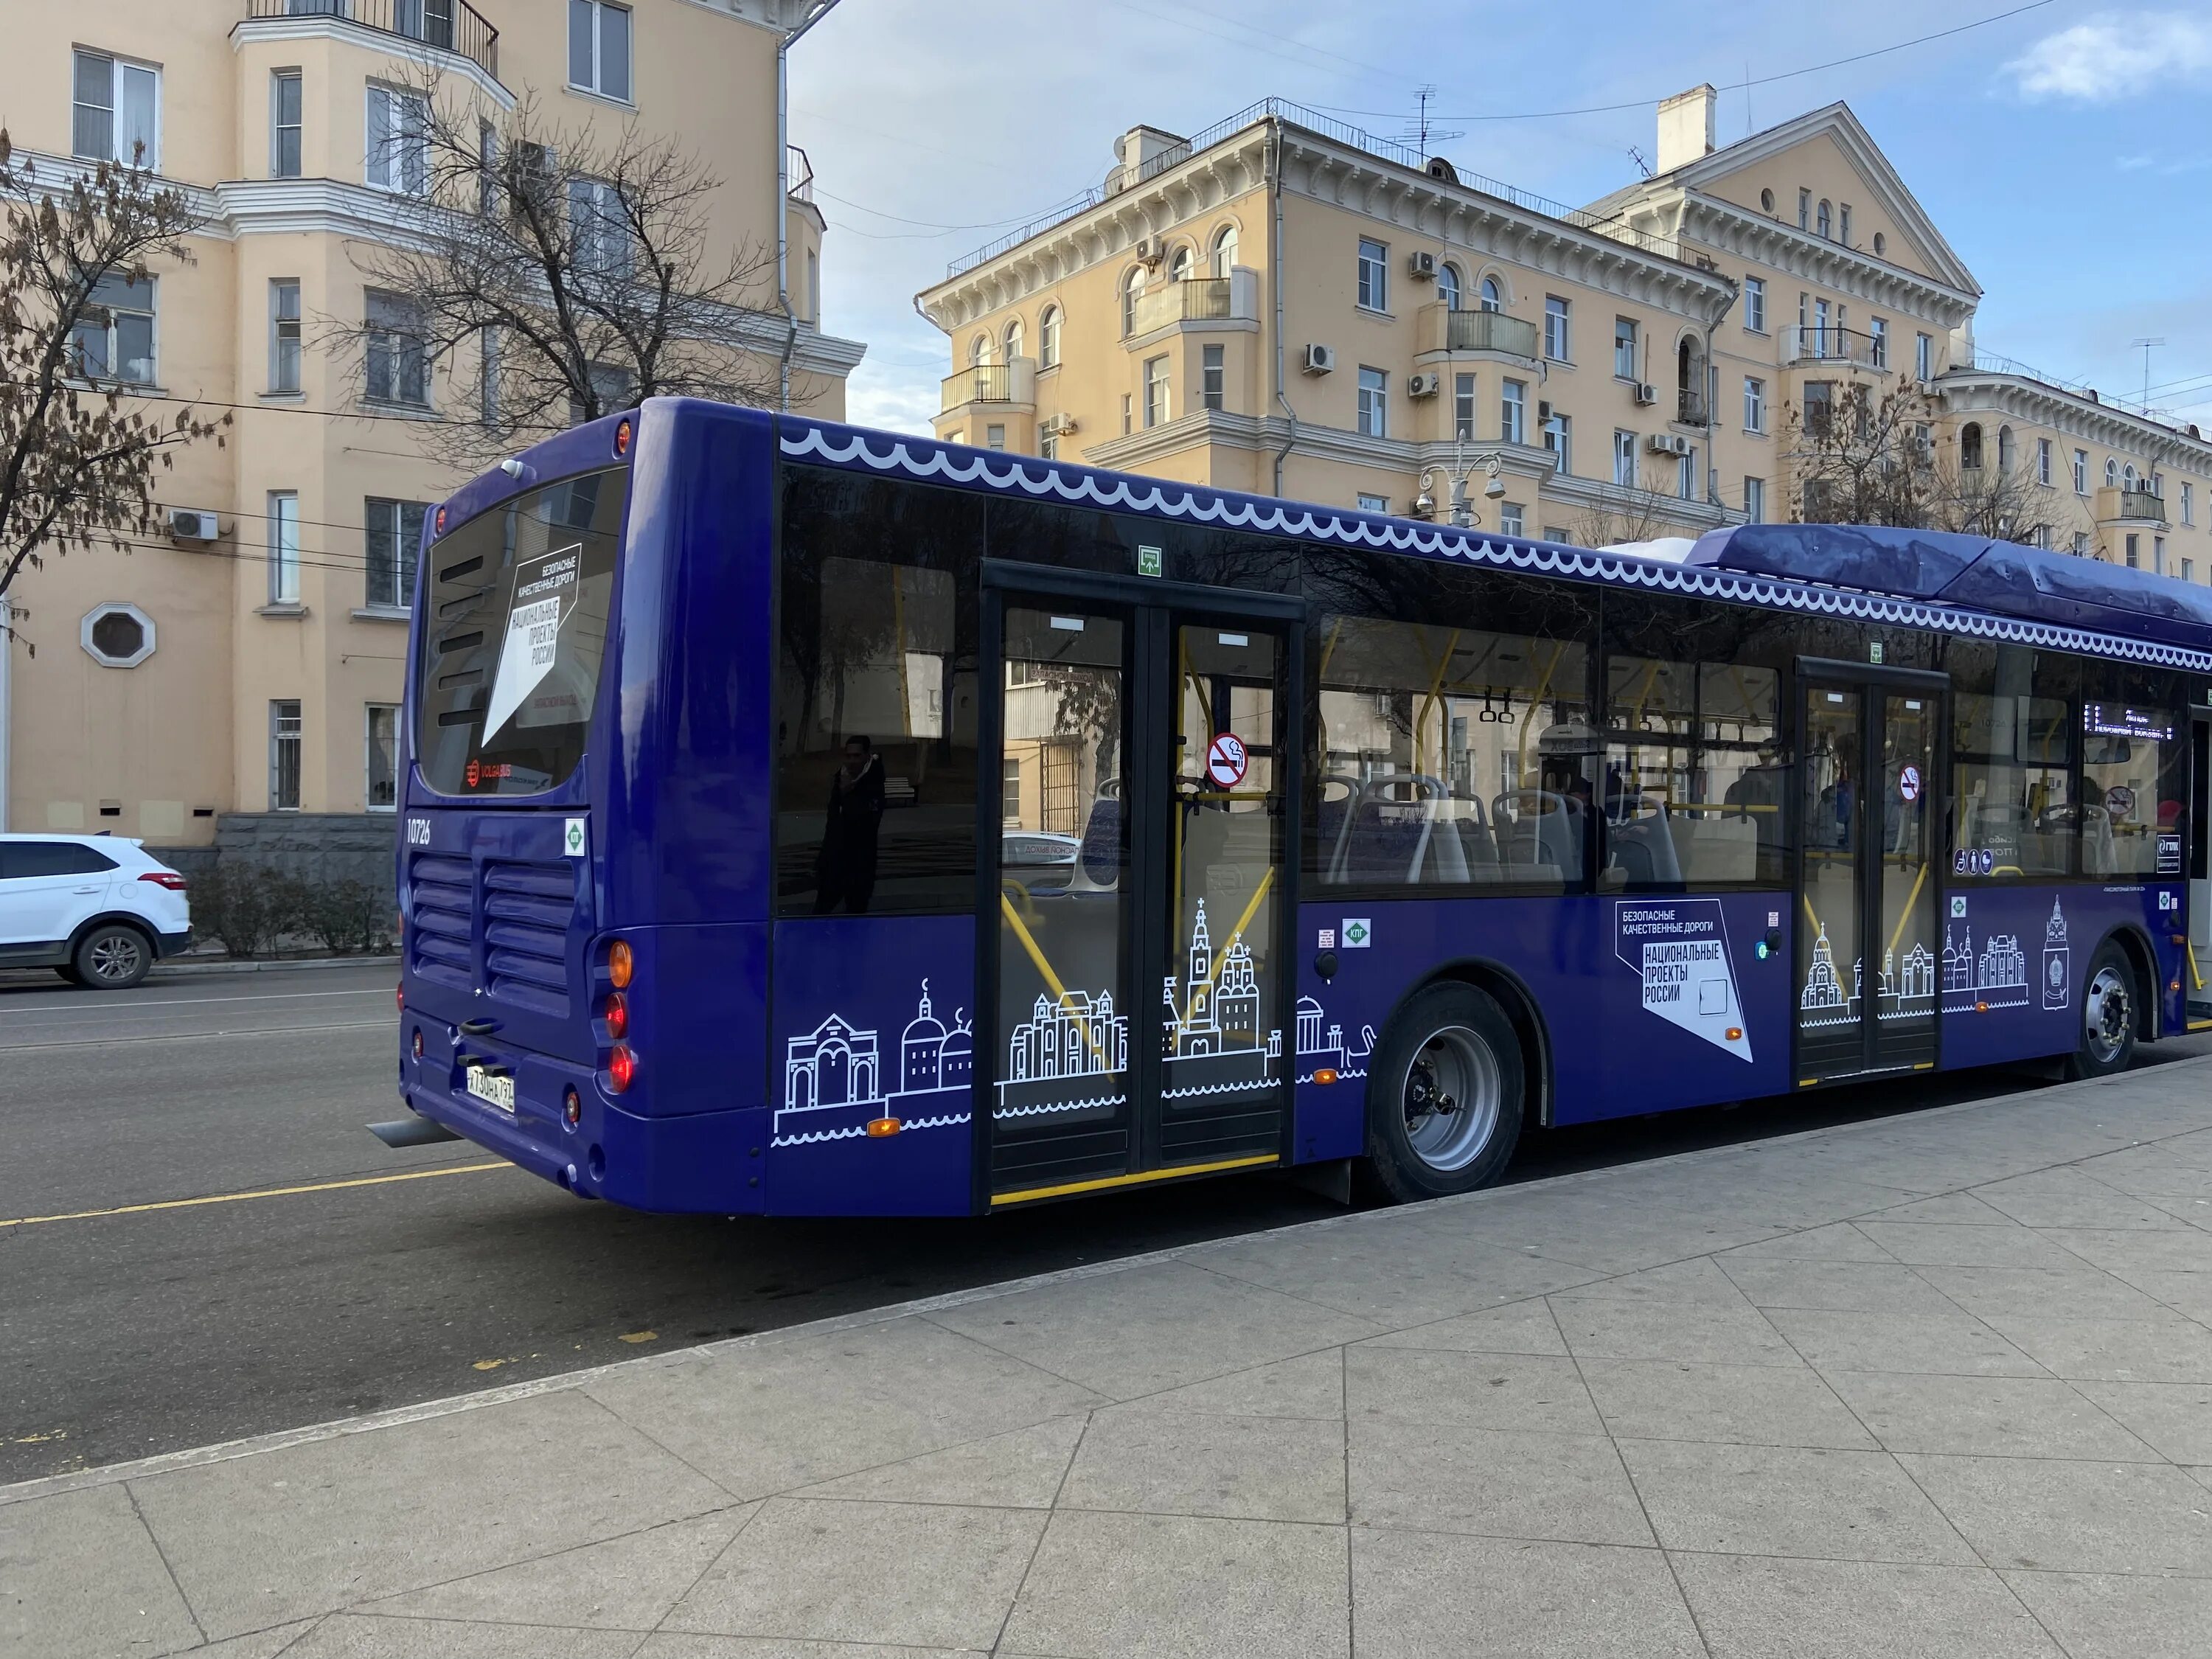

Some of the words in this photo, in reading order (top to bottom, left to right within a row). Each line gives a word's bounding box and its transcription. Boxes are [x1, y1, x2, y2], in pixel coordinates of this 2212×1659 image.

[542, 556, 577, 577] БЕЗОПАСНЫЕ
[518, 577, 555, 599] КАЧЕСТВЕННЫЕ
[554, 571, 575, 590] ДОРОГИ
[512, 599, 558, 630] НАЦИОНАЛЬНЫЕ
[529, 622, 557, 647] ПРОЕКТЫ
[531, 643, 554, 667] РОССИИ
[481, 764, 512, 779] VOLGABUS
[407, 818, 431, 845] 10726
[1622, 910, 1676, 922] БЕЗОПАСНЫЕ
[1350, 928, 1363, 938] КПГ
[1622, 922, 1683, 936] КАЧЕСТВЕННЫЕ
[1683, 921, 1714, 935] ДОРОГИ
[1645, 943, 1719, 965] НАЦИОНАЛЬНЫЕ
[1645, 964, 1688, 984] ПРОЕКТЫ
[1645, 984, 1680, 1004] РОССИИ
